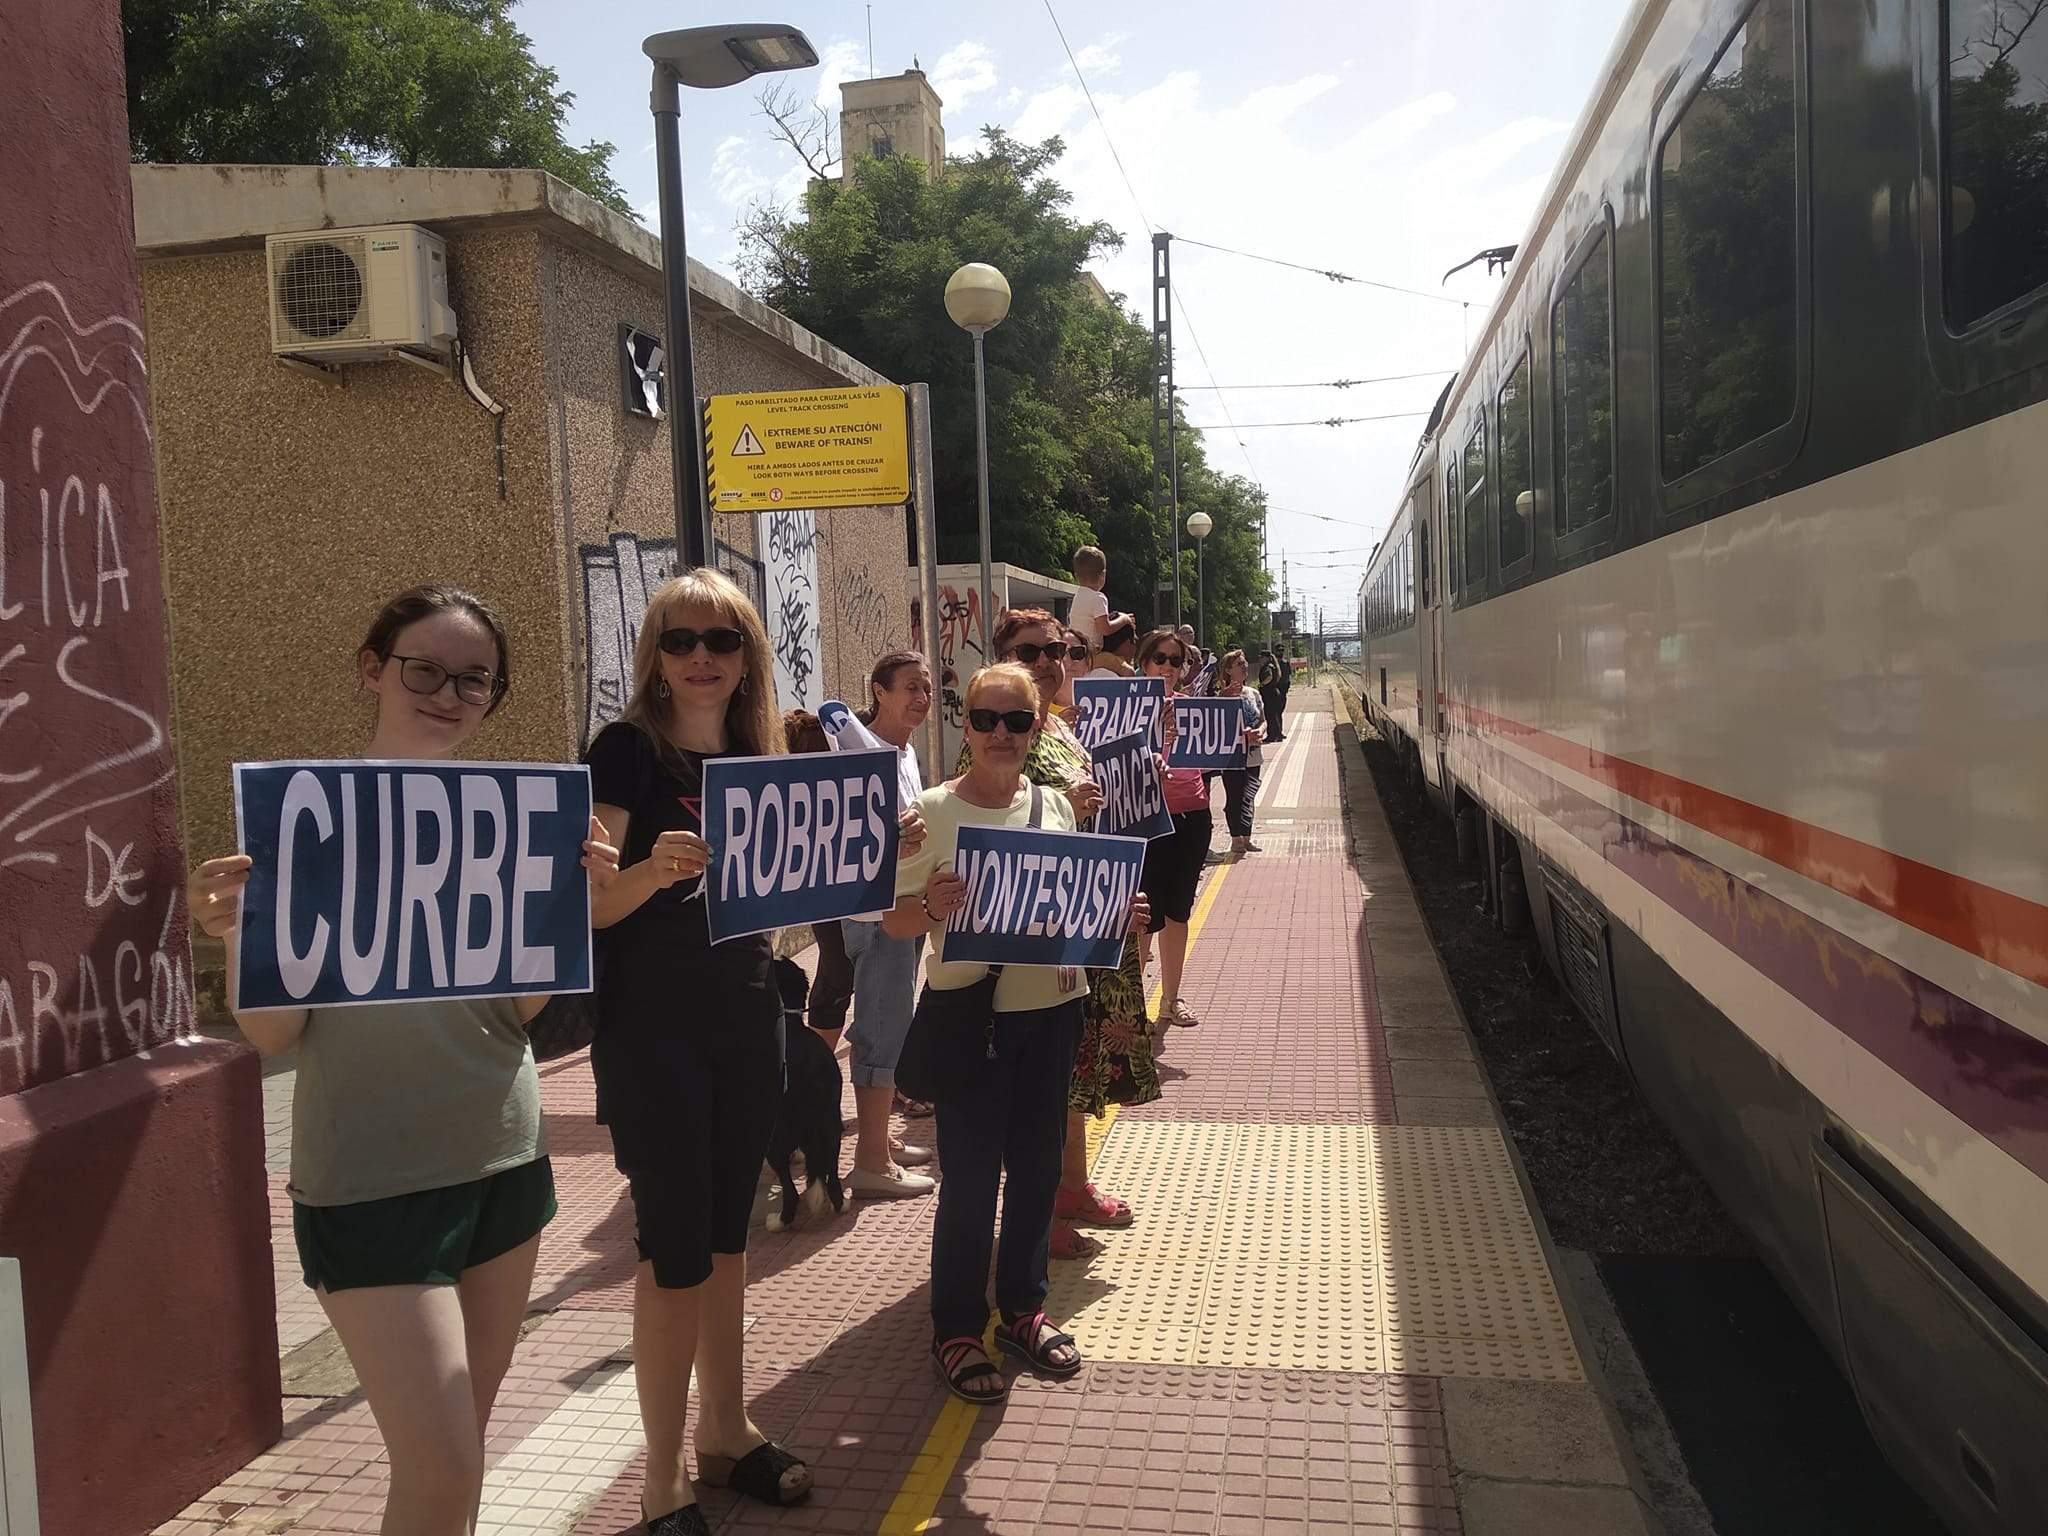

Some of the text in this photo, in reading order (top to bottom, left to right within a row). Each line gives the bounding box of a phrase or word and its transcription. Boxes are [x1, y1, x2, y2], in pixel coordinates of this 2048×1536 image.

[764, 422, 882, 436] ¡EXTREME SU ATENCIÓN!
[775, 437, 873, 449] BEWARE OF TRAINS!
[1172, 708, 1246, 755] FRULA
[1094, 746, 1161, 834] PIRACES
[85, 825, 146, 907] DE
[721, 773, 886, 902] ROBRES
[276, 770, 558, 999] CURBE
[947, 848, 1137, 940] MONTESUSIN
